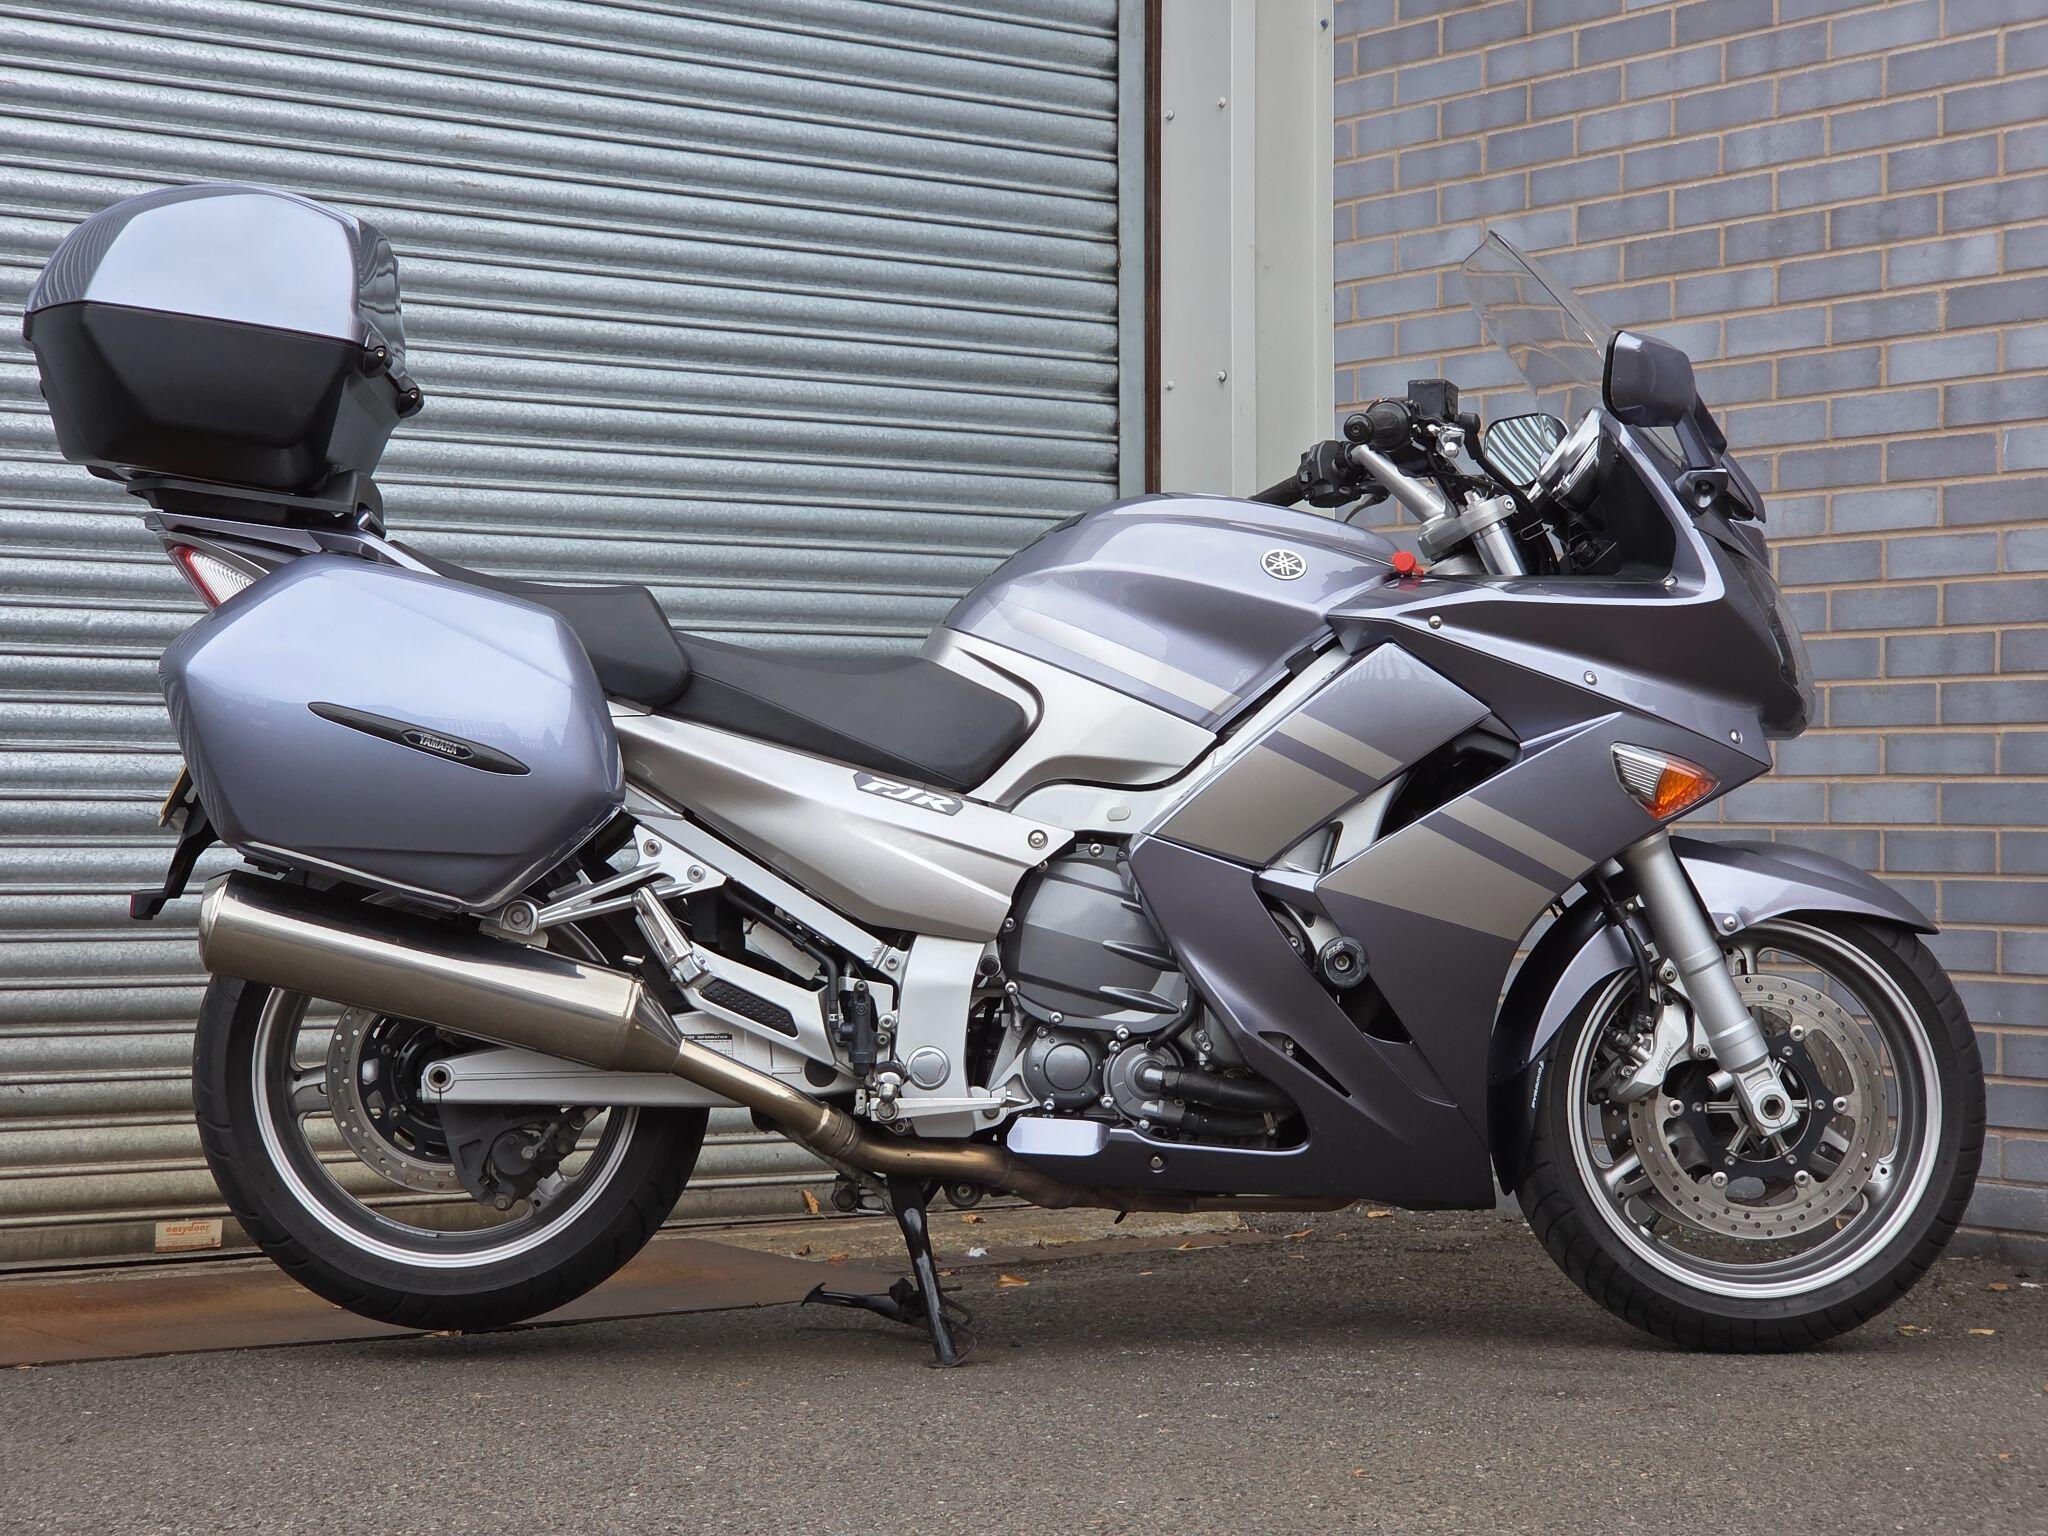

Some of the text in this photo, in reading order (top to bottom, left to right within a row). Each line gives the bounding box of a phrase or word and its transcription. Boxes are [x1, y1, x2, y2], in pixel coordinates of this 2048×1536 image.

[419, 732, 457, 755] YAMAHA
[860, 776, 956, 813] FJR
[165, 1222, 211, 1235] easydoor
